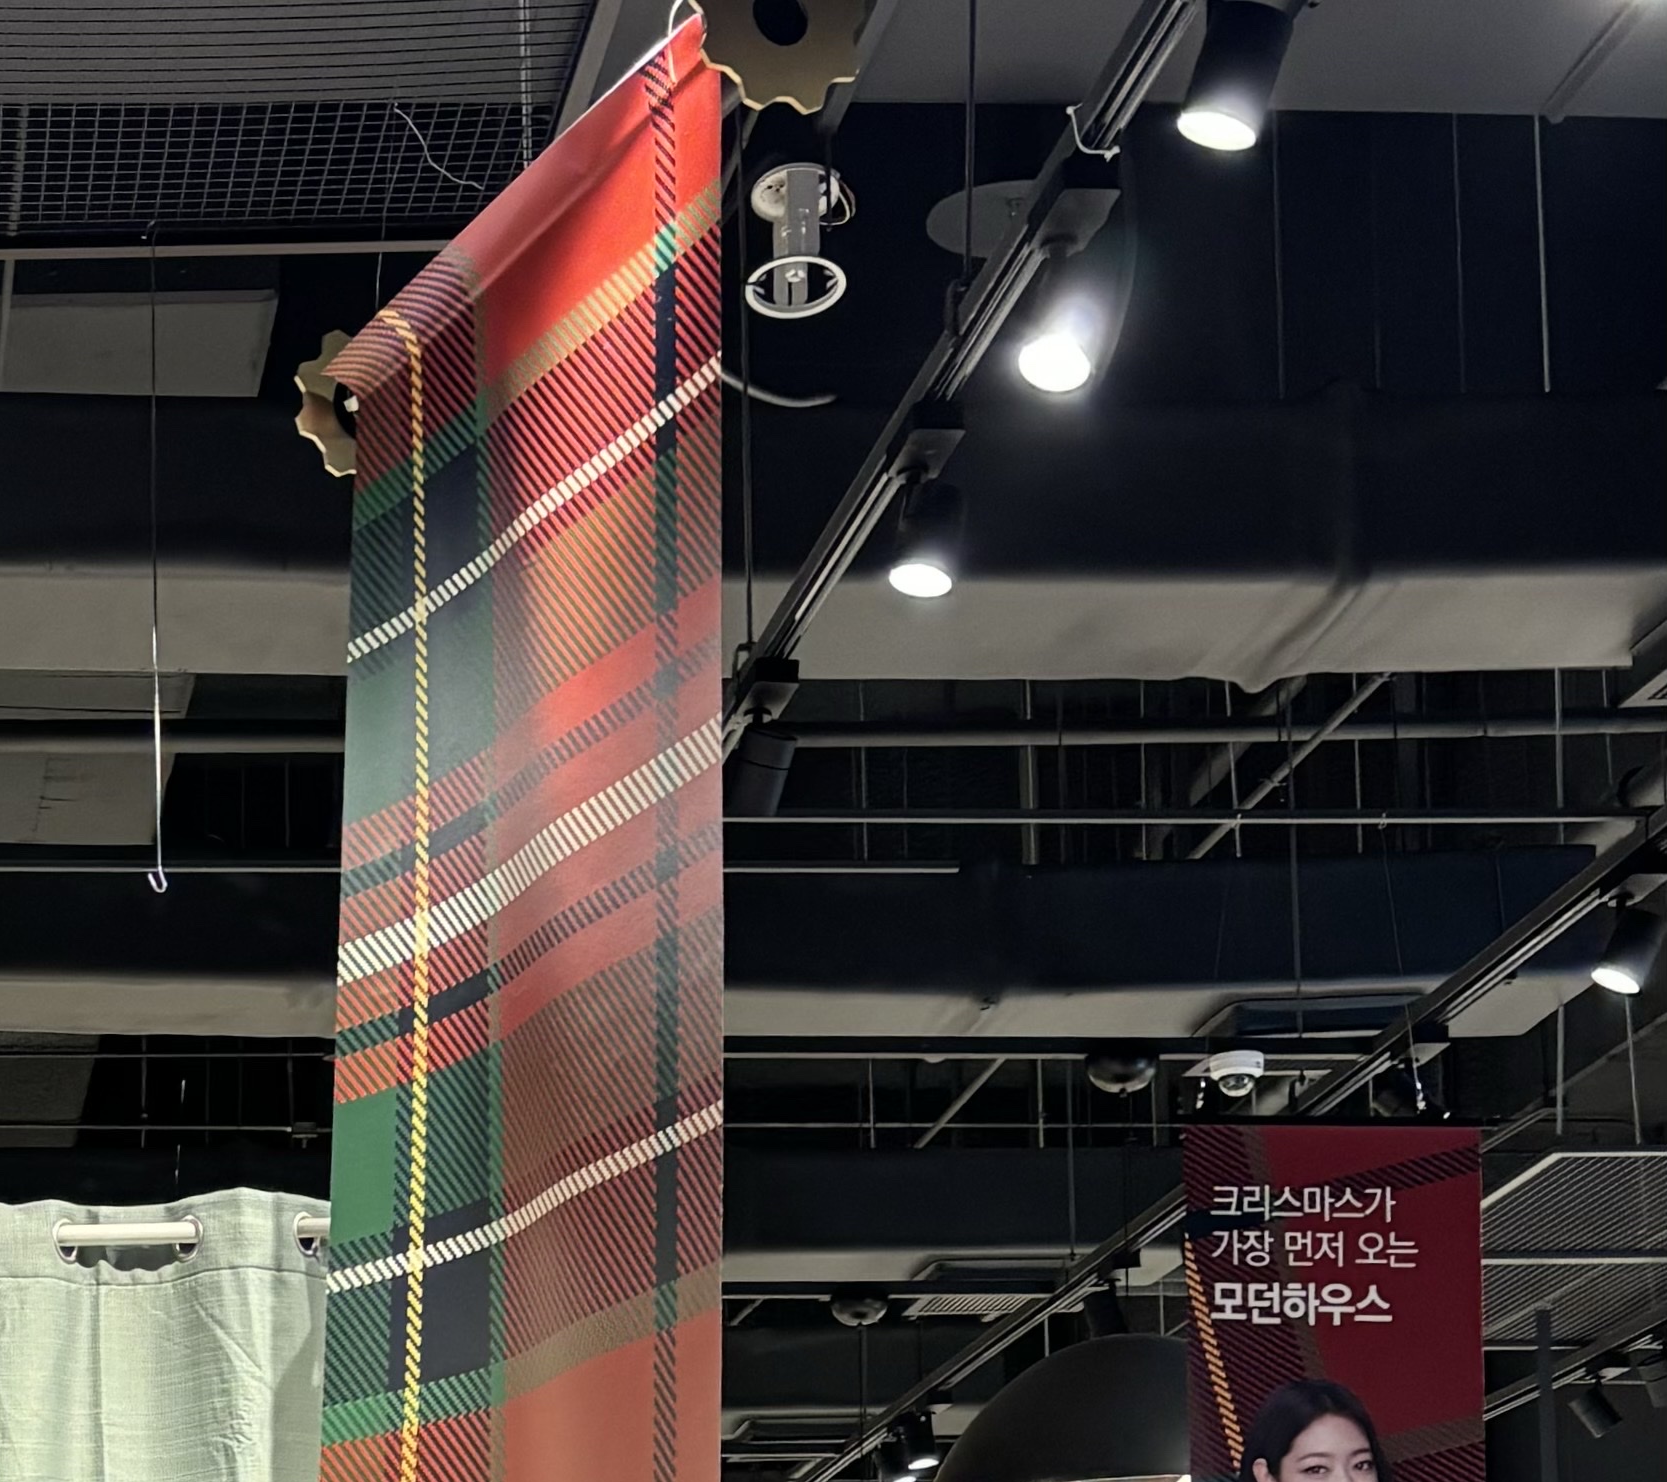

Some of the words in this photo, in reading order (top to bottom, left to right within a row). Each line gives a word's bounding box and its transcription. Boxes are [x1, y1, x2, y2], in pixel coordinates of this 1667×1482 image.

[1210, 1184, 1396, 1223] 크리스마스가
[1211, 1229, 1274, 1267] 가장
[1284, 1230, 1344, 1267] 먼저
[1354, 1231, 1419, 1268] 오는
[1210, 1282, 1393, 1326] 모던하우스
